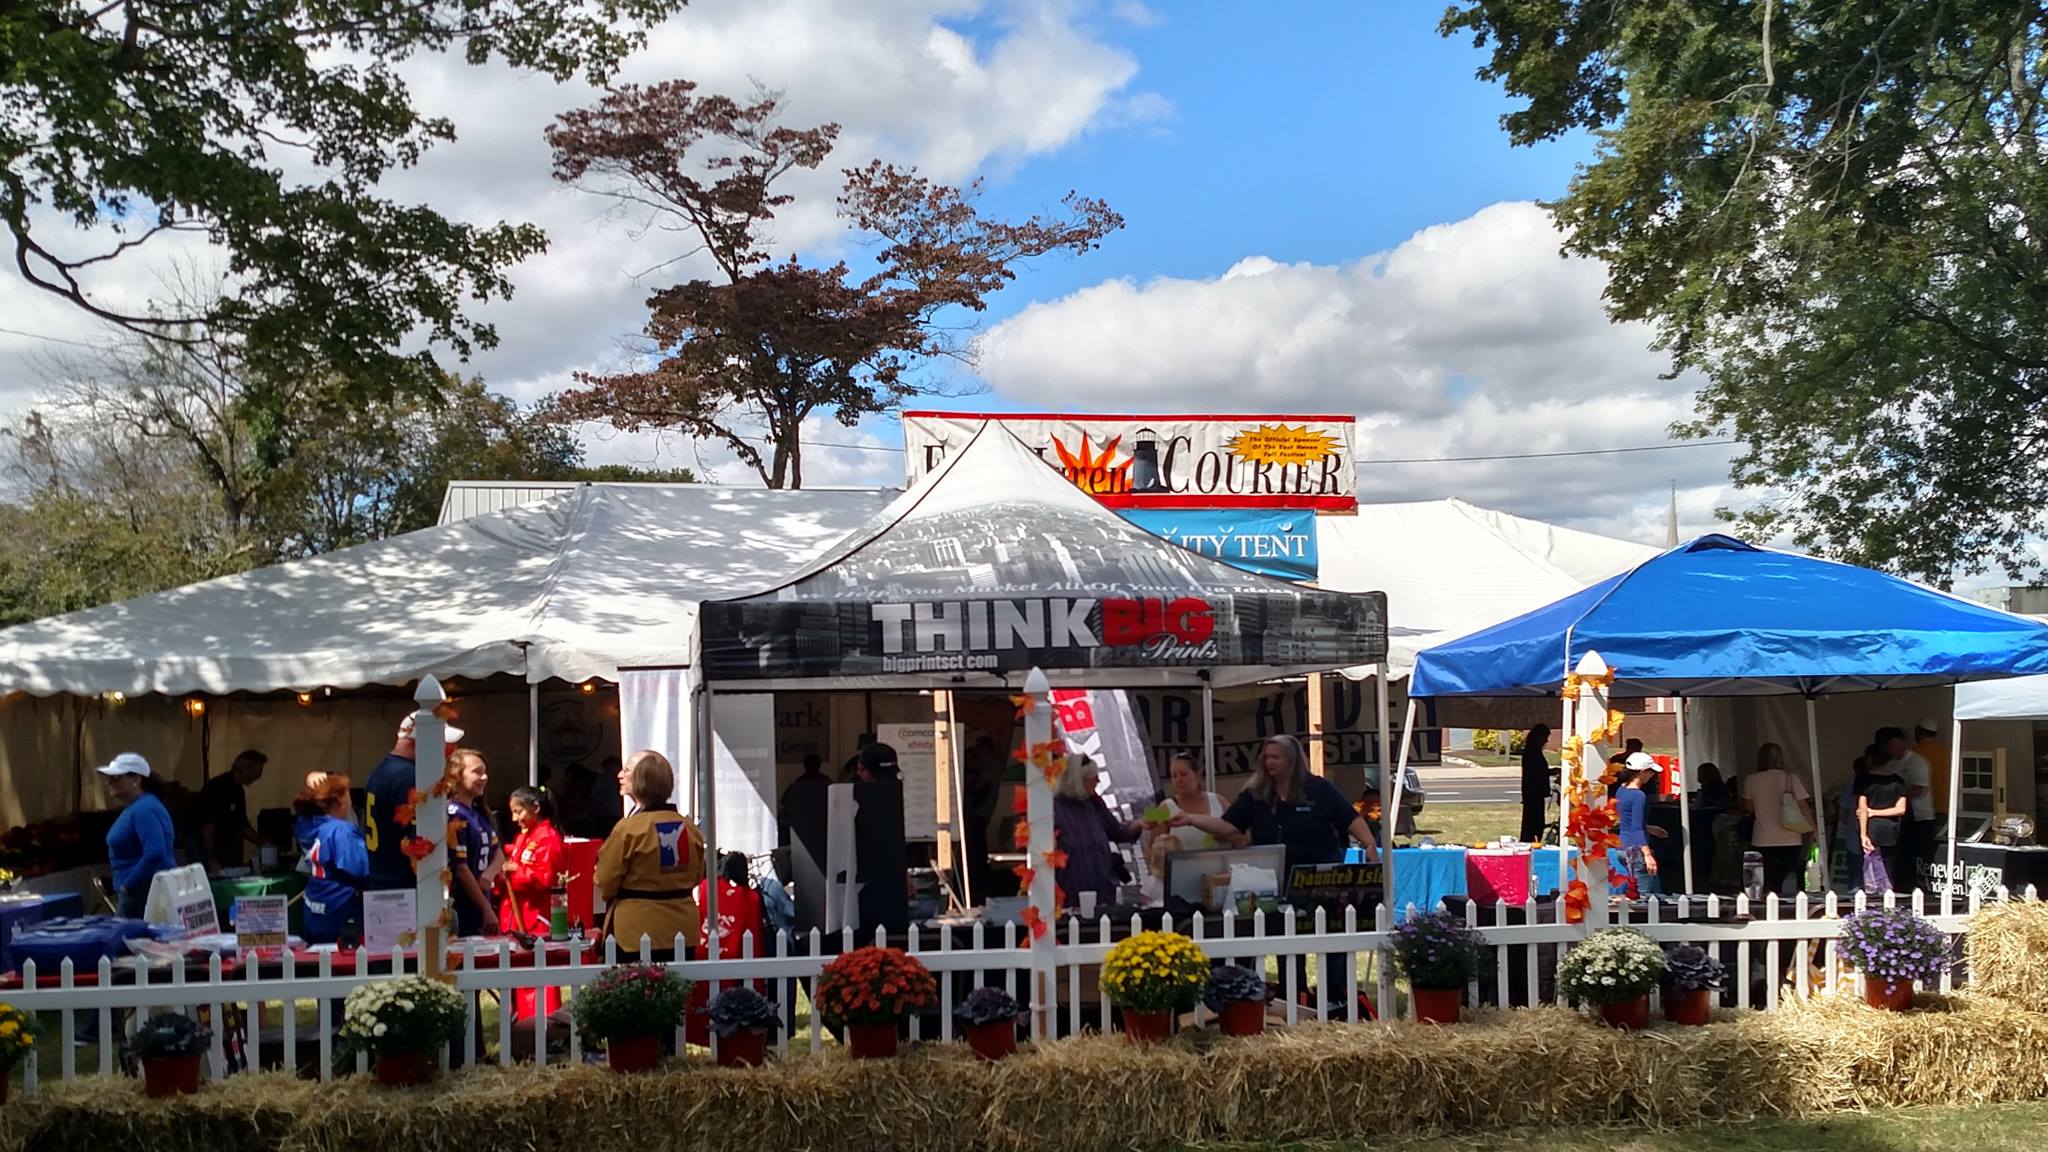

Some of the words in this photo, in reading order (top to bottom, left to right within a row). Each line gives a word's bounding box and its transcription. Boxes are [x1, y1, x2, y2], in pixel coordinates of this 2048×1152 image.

[1163, 436, 1342, 495] COURIER
[1234, 534, 1308, 558] TENT
[903, 586, 943, 596] You
[953, 583, 1040, 595] Market
[1047, 581, 1089, 592] All
[1128, 582, 1179, 593] Your
[872, 598, 1099, 653] THINK
[1103, 597, 1215, 646] BIG
[1142, 633, 1218, 660] Prints
[883, 655, 998, 673] bigprintsct.com
